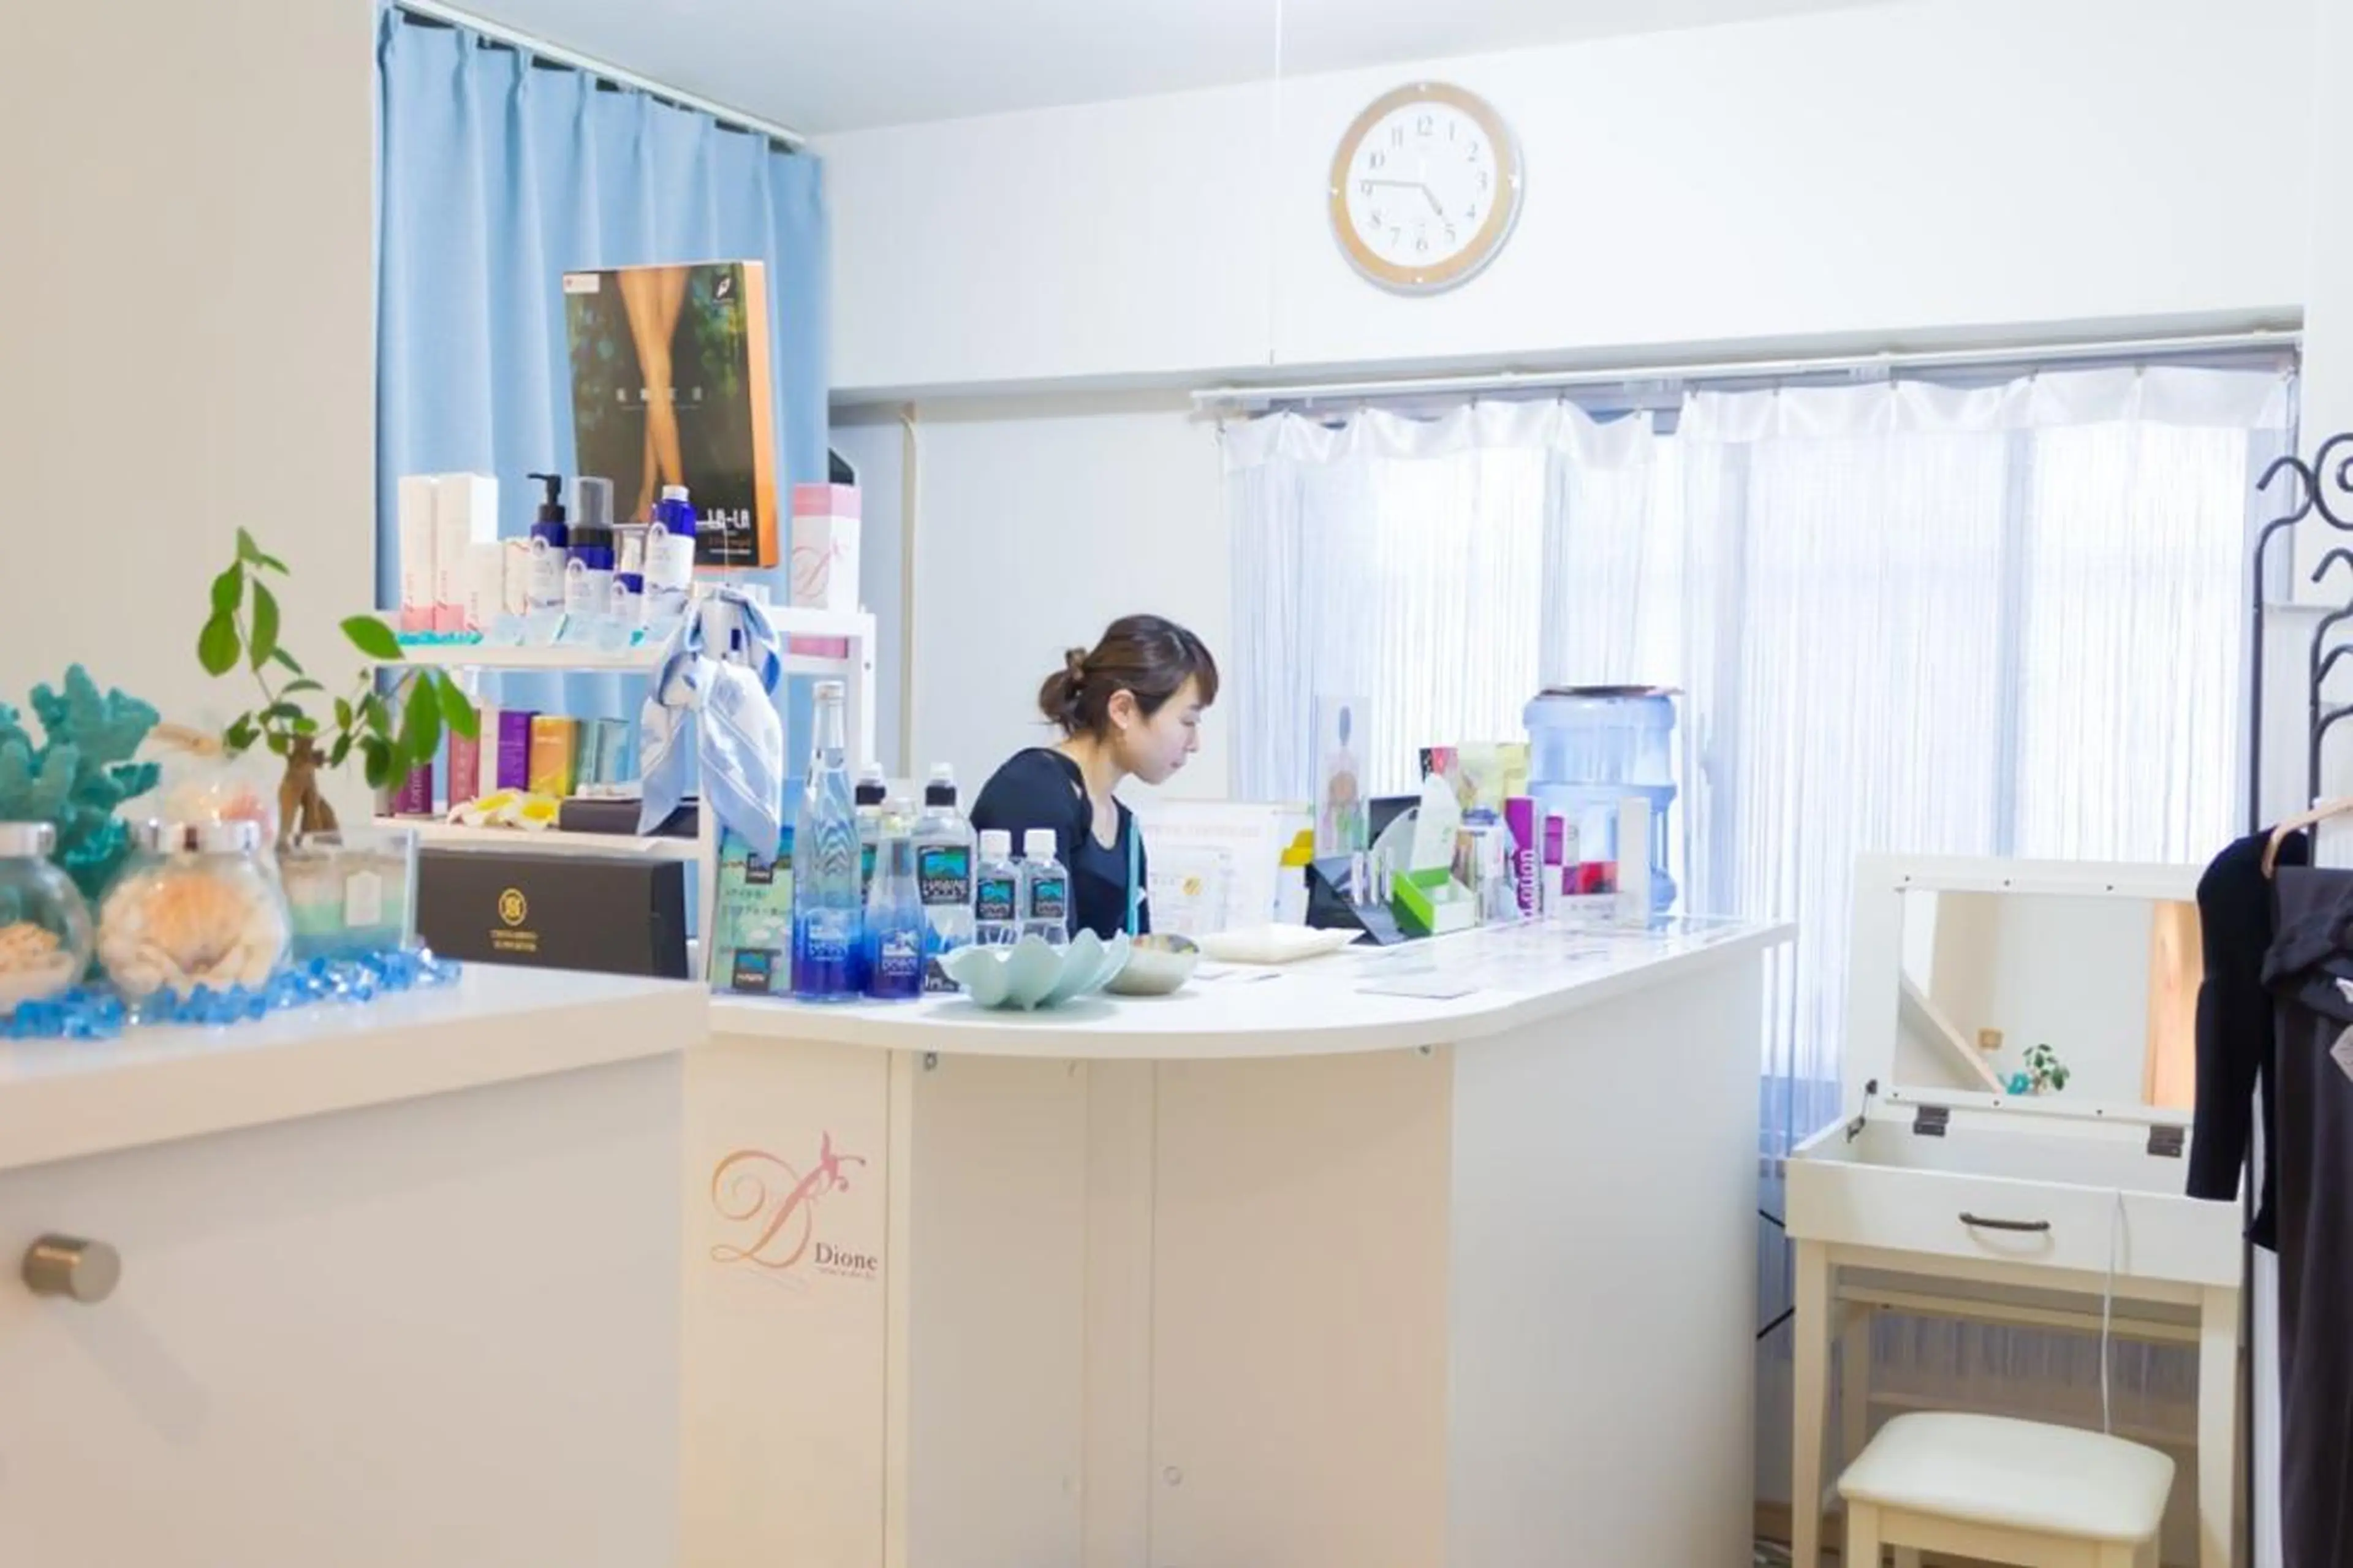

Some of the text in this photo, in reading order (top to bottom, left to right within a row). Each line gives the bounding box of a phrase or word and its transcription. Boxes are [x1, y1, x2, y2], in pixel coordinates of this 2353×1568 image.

[1417, 115, 1433, 136] 12
[1449, 119, 1455, 141] 1
[1390, 126, 1404, 148] 11
[1369, 150, 1385, 169] 10
[1466, 140, 1478, 162] 2
[1465, 203, 1477, 220] 4
[1389, 226, 1401, 248] 7
[1444, 222, 1457, 244] 5
[814, 1241, 878, 1271] Dione
